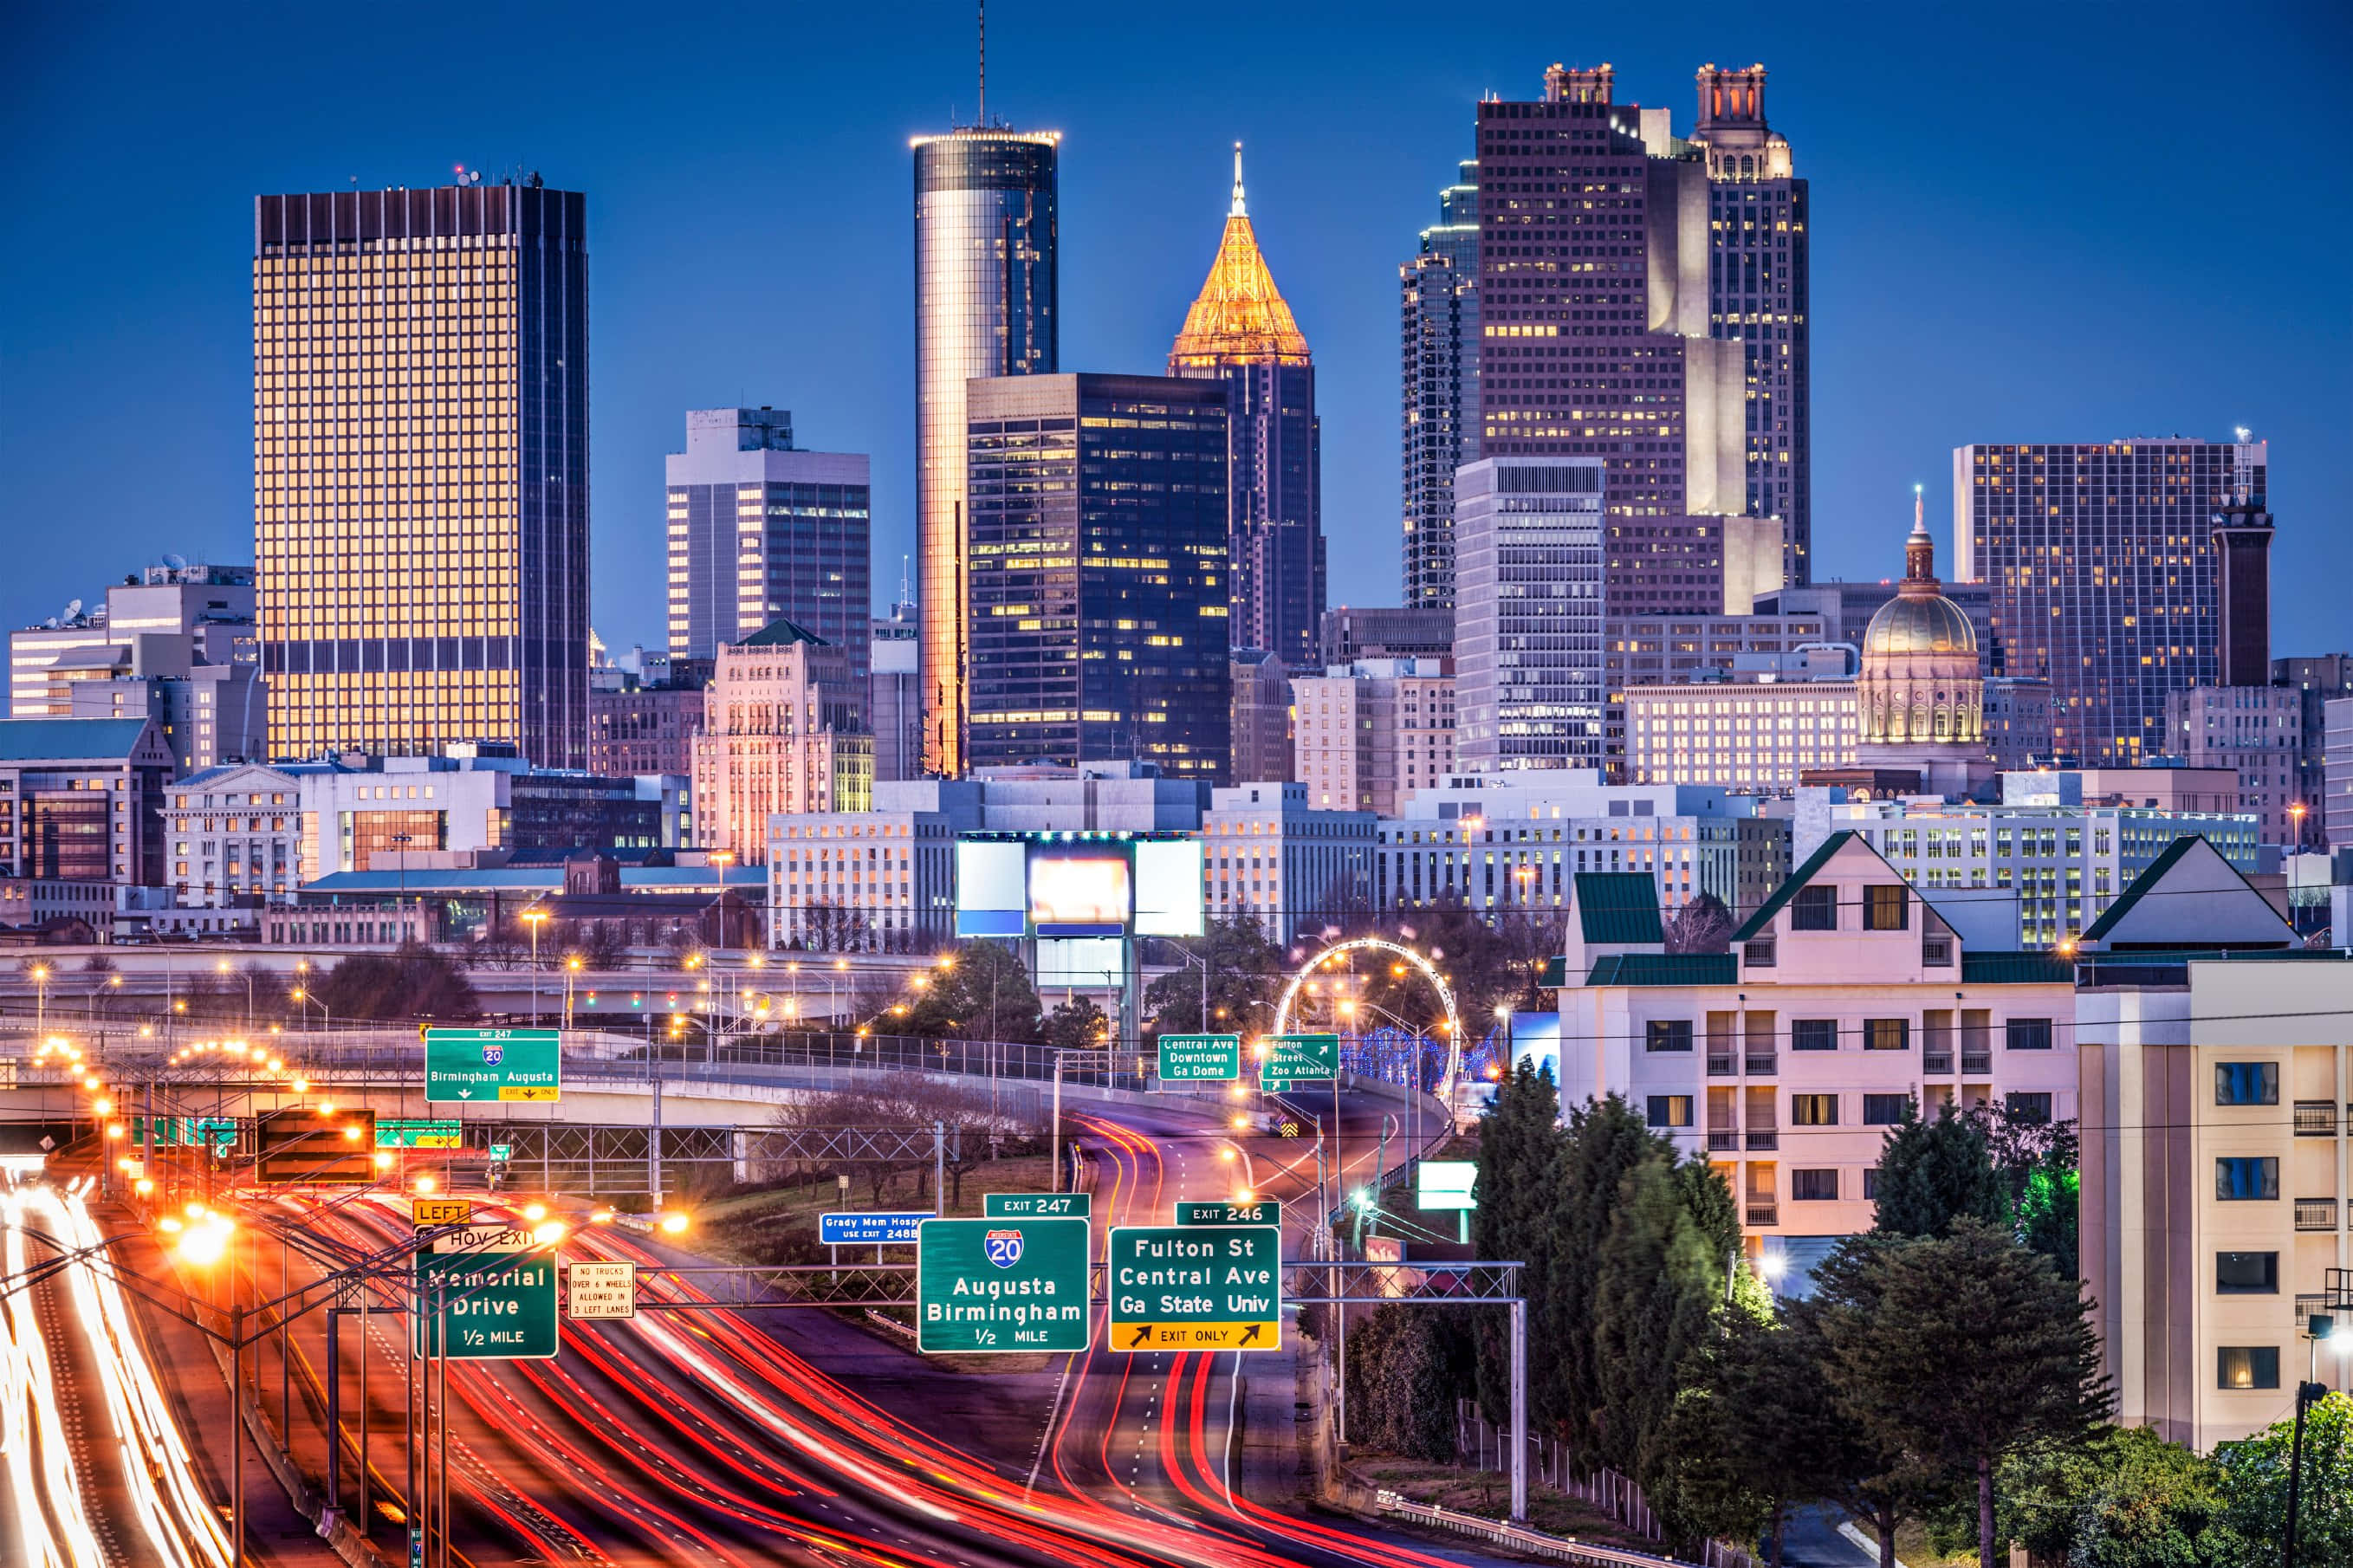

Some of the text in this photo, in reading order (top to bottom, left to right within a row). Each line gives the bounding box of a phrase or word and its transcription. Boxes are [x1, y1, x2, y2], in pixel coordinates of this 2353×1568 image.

[495, 1029, 511, 1039] 247
[1164, 1039, 1234, 1050] Central Ave
[1272, 1040, 1302, 1049] Fulton
[486, 1051, 501, 1061] 20
[1170, 1052, 1228, 1063] Downtown
[1272, 1053, 1302, 1062] Street
[1173, 1066, 1225, 1076] Ga Dome
[1272, 1066, 1330, 1075] Zoo Atlanta
[431, 1071, 553, 1084] Birmingham Augusta
[1004, 1200, 1072, 1213] EXIT 247
[420, 1207, 463, 1220] LEFT
[1193, 1208, 1263, 1221] EXIT 246
[826, 1218, 857, 1228] Grady
[891, 1218, 917, 1227] Hosp
[451, 1232, 489, 1246] HOV
[991, 1240, 1021, 1260] 20
[1136, 1239, 1254, 1257] Fulton St
[429, 1268, 544, 1286] Memorial
[1119, 1267, 1270, 1286] Central Ave
[953, 1277, 1055, 1299] Augusta
[453, 1298, 520, 1315] Drive
[1119, 1295, 1270, 1313] Ga State Univ
[927, 1303, 1080, 1325] Birmingham
[490, 1332, 524, 1343] MILE
[1014, 1332, 1048, 1342] MILE
[1161, 1331, 1228, 1342] EXIT ONLY
